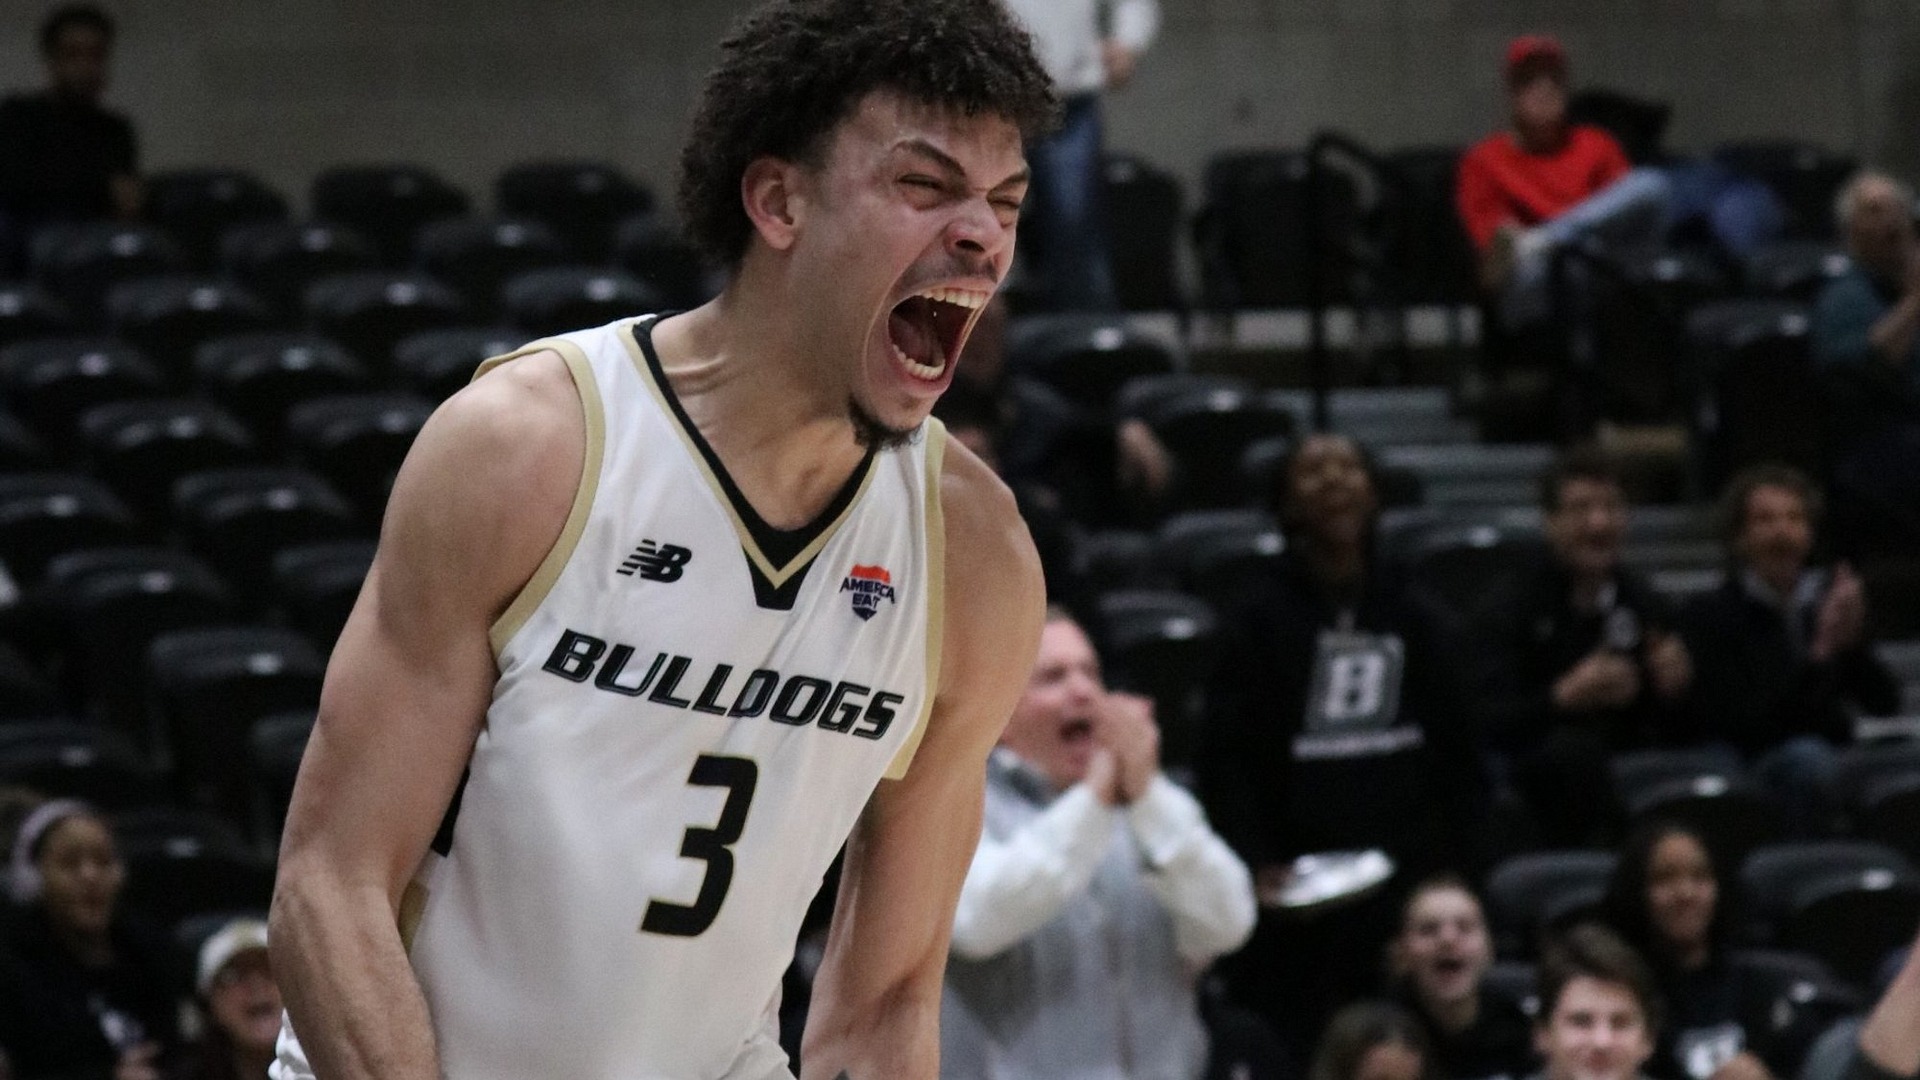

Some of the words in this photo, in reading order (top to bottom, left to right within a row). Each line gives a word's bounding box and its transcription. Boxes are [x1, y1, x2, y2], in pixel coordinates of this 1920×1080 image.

[616, 539, 692, 583] NB
[839, 576, 895, 604] AMERCA
[852, 593, 881, 609] EAT
[541, 628, 905, 741] BULLDOGS
[1324, 653, 1385, 720] B
[639, 753, 758, 938] 3
